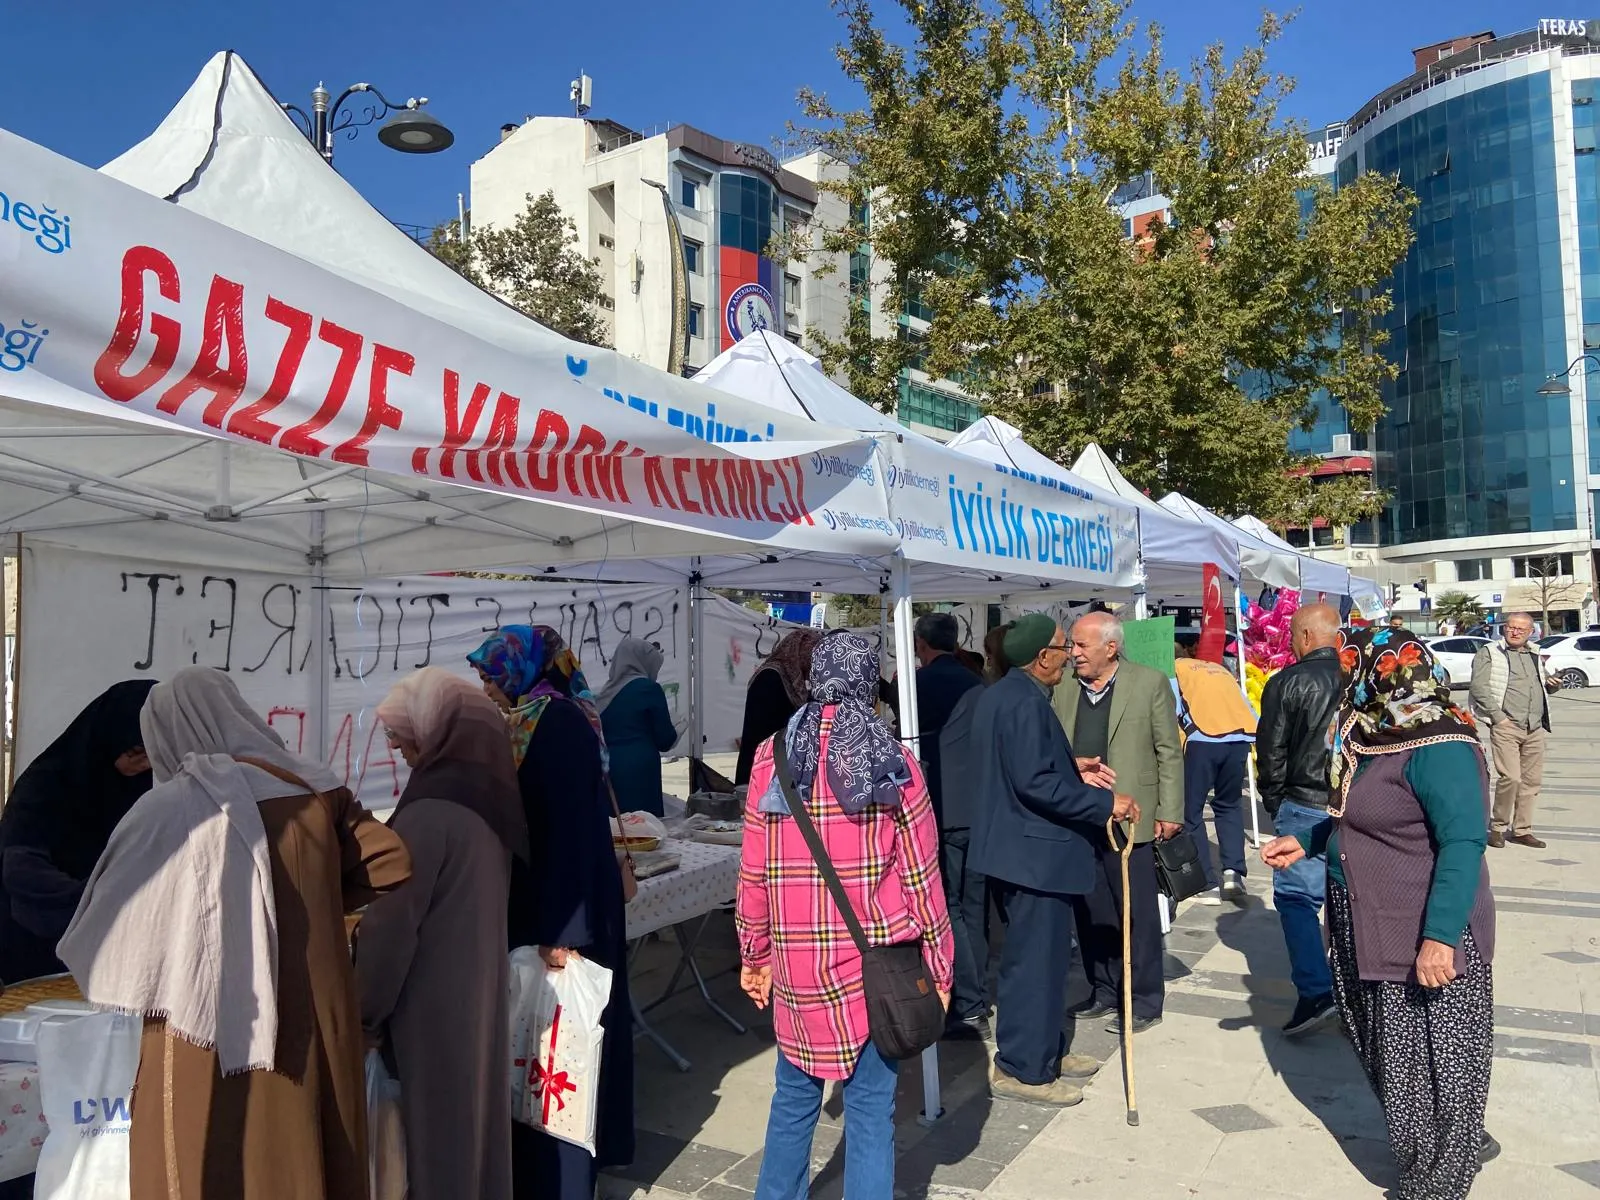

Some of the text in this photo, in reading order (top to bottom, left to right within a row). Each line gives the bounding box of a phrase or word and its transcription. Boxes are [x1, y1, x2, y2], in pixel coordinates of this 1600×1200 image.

[1540, 18, 1586, 37] TERAS
[94, 245, 416, 467] GAZZE
[948, 474, 1031, 561] İYİLİK
[1031, 507, 1114, 574] DERNEĞİ
